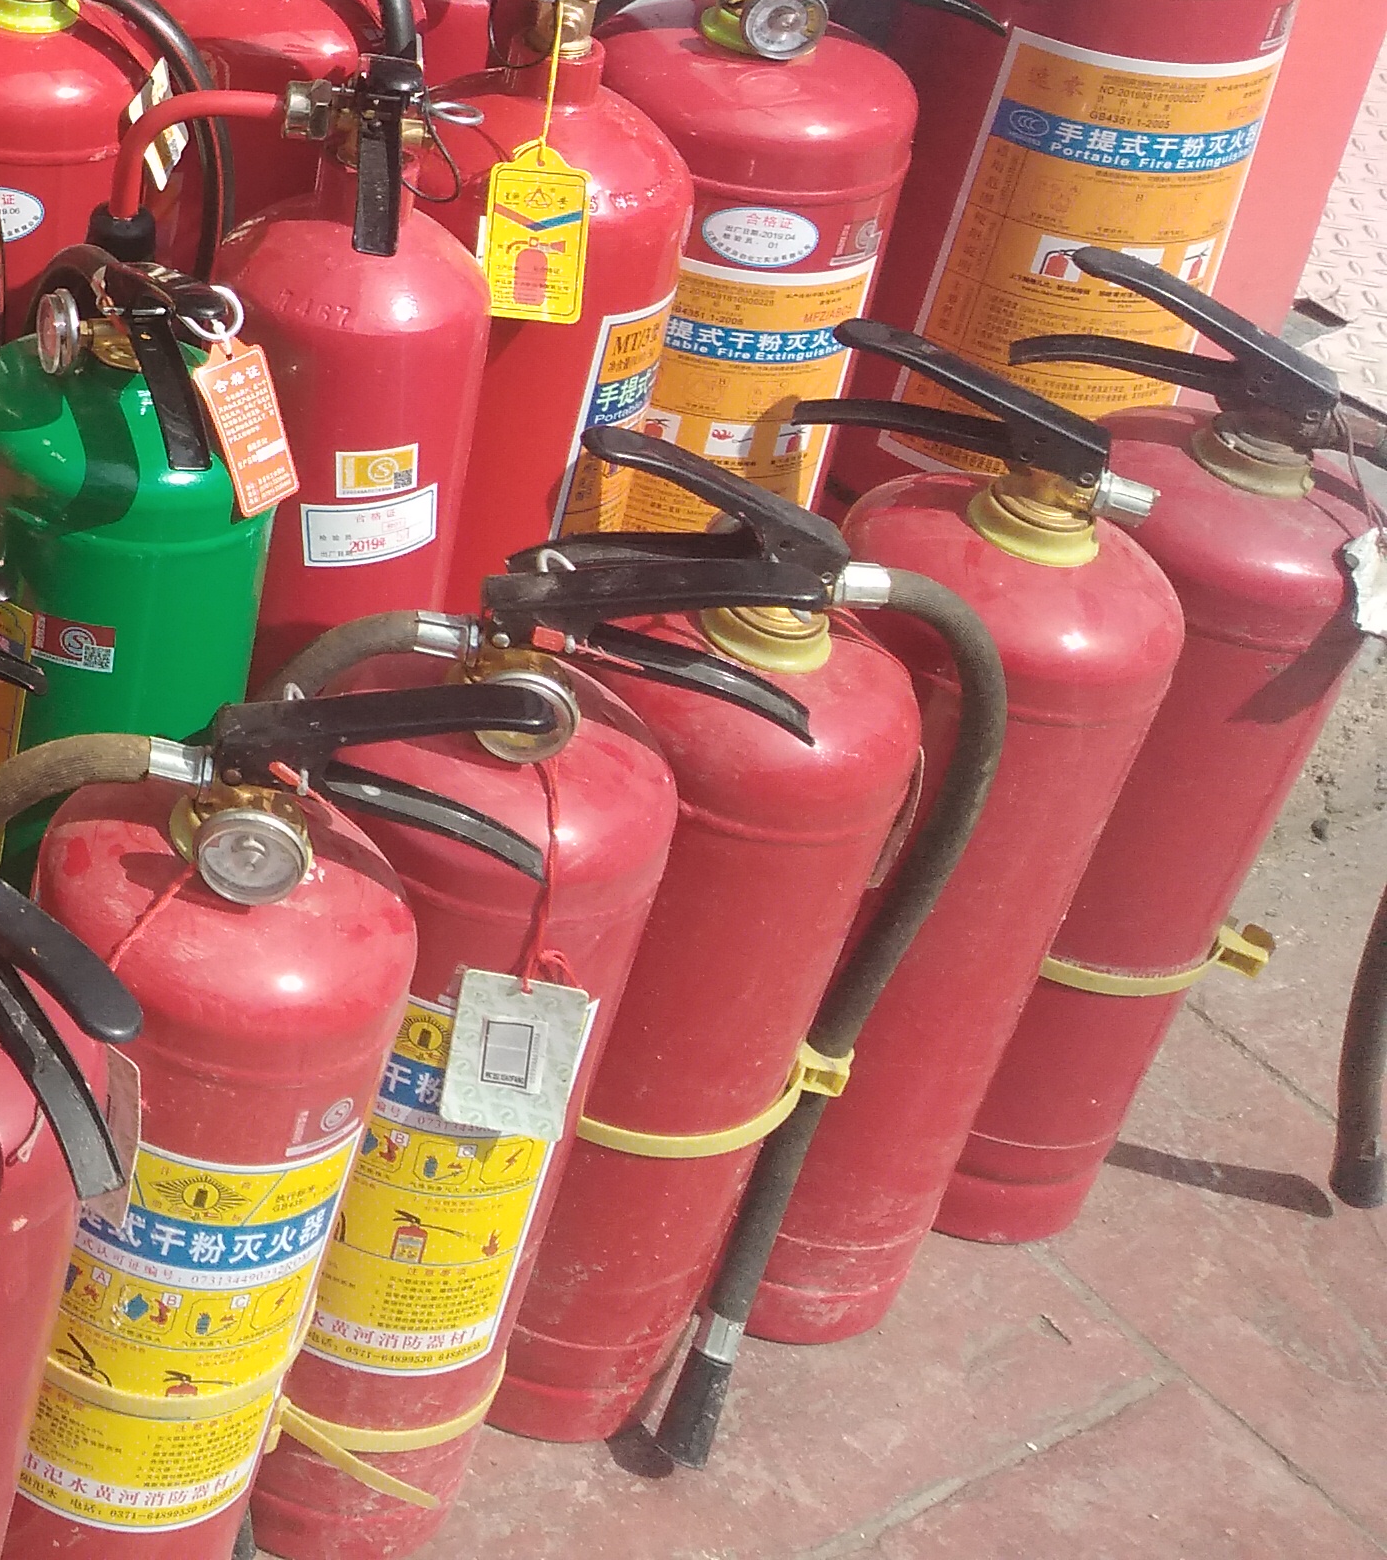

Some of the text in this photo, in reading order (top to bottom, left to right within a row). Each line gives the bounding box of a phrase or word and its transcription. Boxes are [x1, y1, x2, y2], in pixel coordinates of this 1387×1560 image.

[1055, 121, 1260, 158] 手提式干粉灭火器
[1050, 142, 1130, 167] Portable
[1138, 156, 1173, 170] Fire
[745, 212, 795, 230] 合格证
[666, 318, 841, 353] 提式干粉灭火
[717, 347, 751, 361] Fire
[212, 364, 261, 394] 合格证
[355, 508, 396, 524] 合格证
[93, 1269, 246, 1308] A B C
